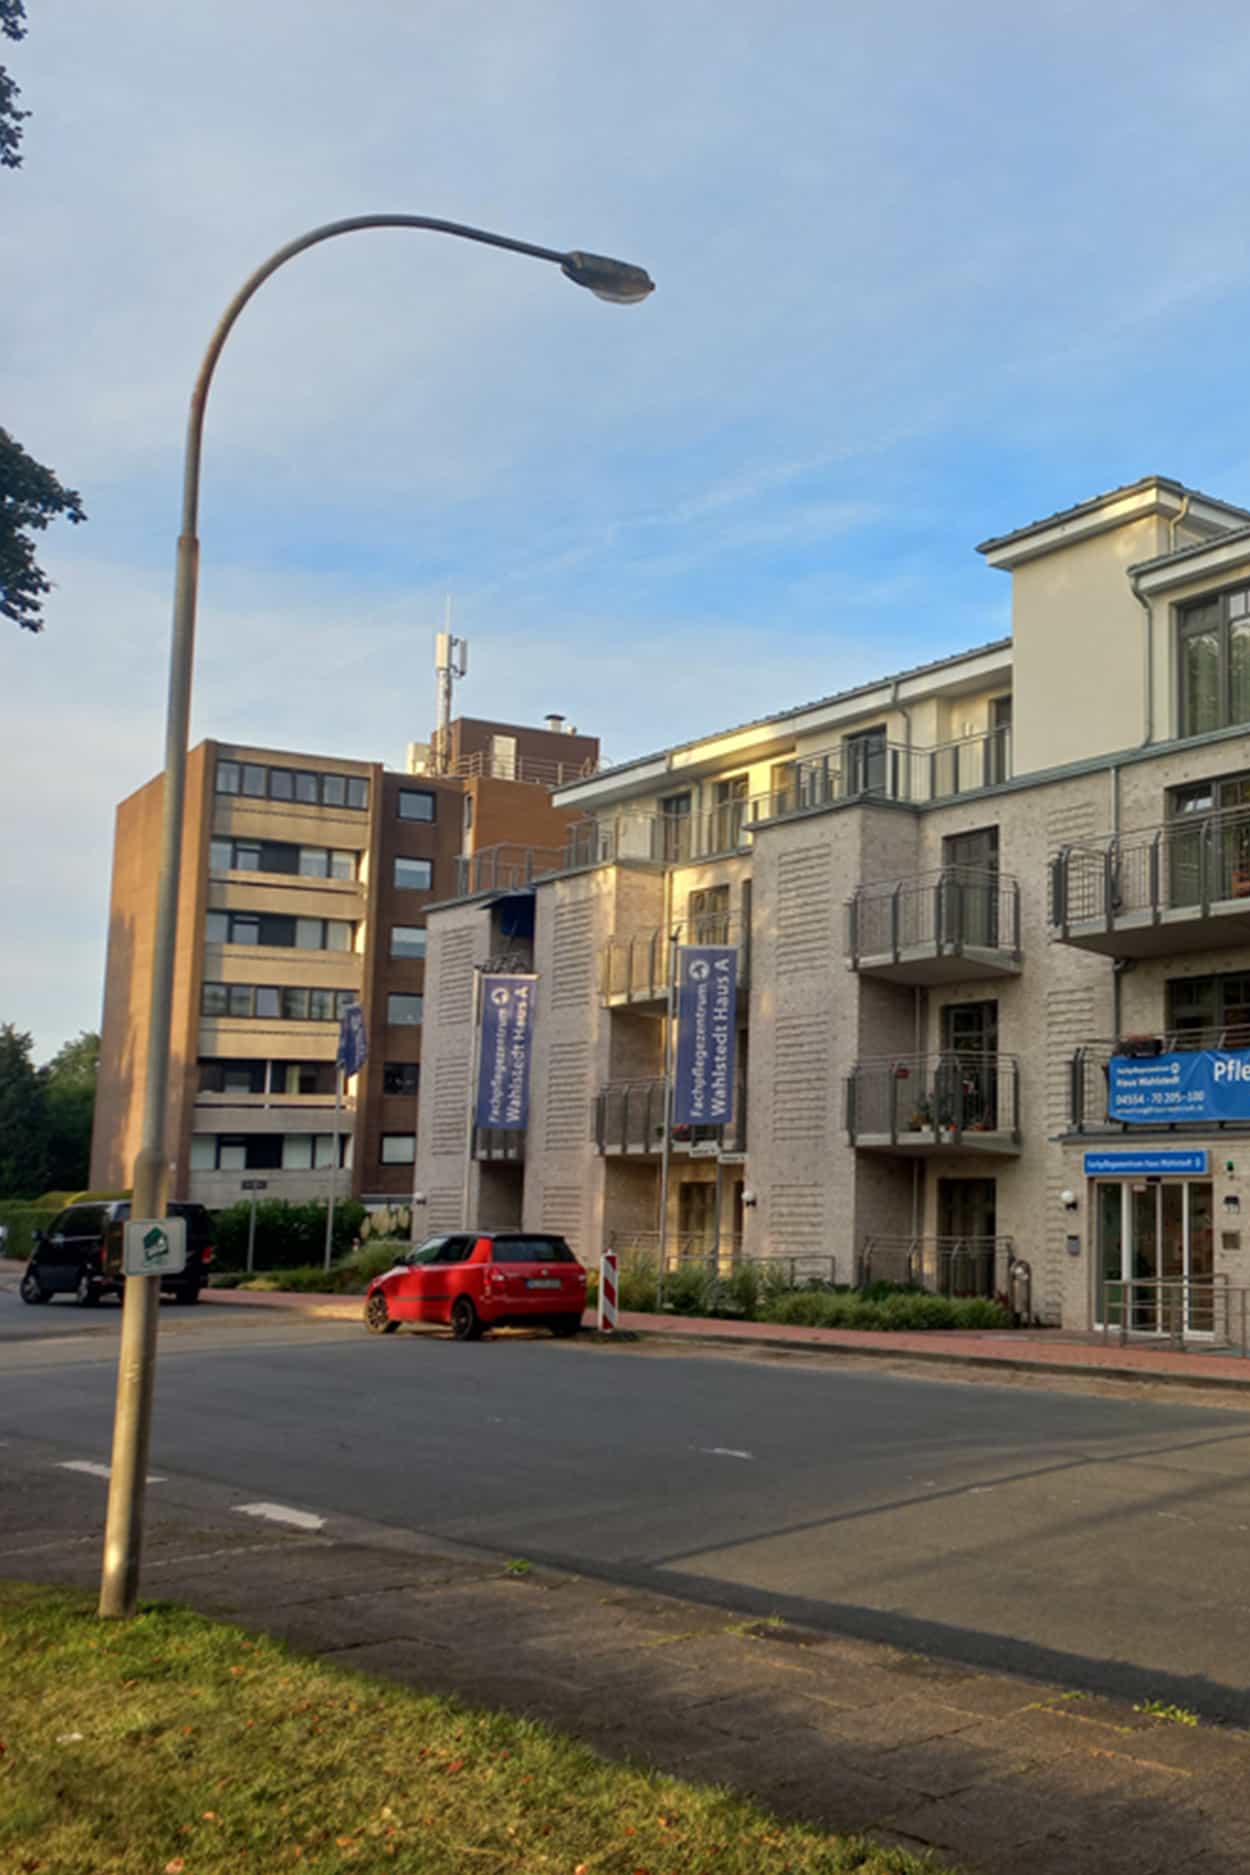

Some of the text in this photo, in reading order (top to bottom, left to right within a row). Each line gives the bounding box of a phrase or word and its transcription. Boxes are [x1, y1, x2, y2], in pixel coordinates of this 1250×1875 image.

[506, 986, 529, 1122] Wahlstedt Haus A
[690, 983, 708, 1118] Fachpflegezentrum
[711, 958, 730, 1117] Wahlstedt Haus A
